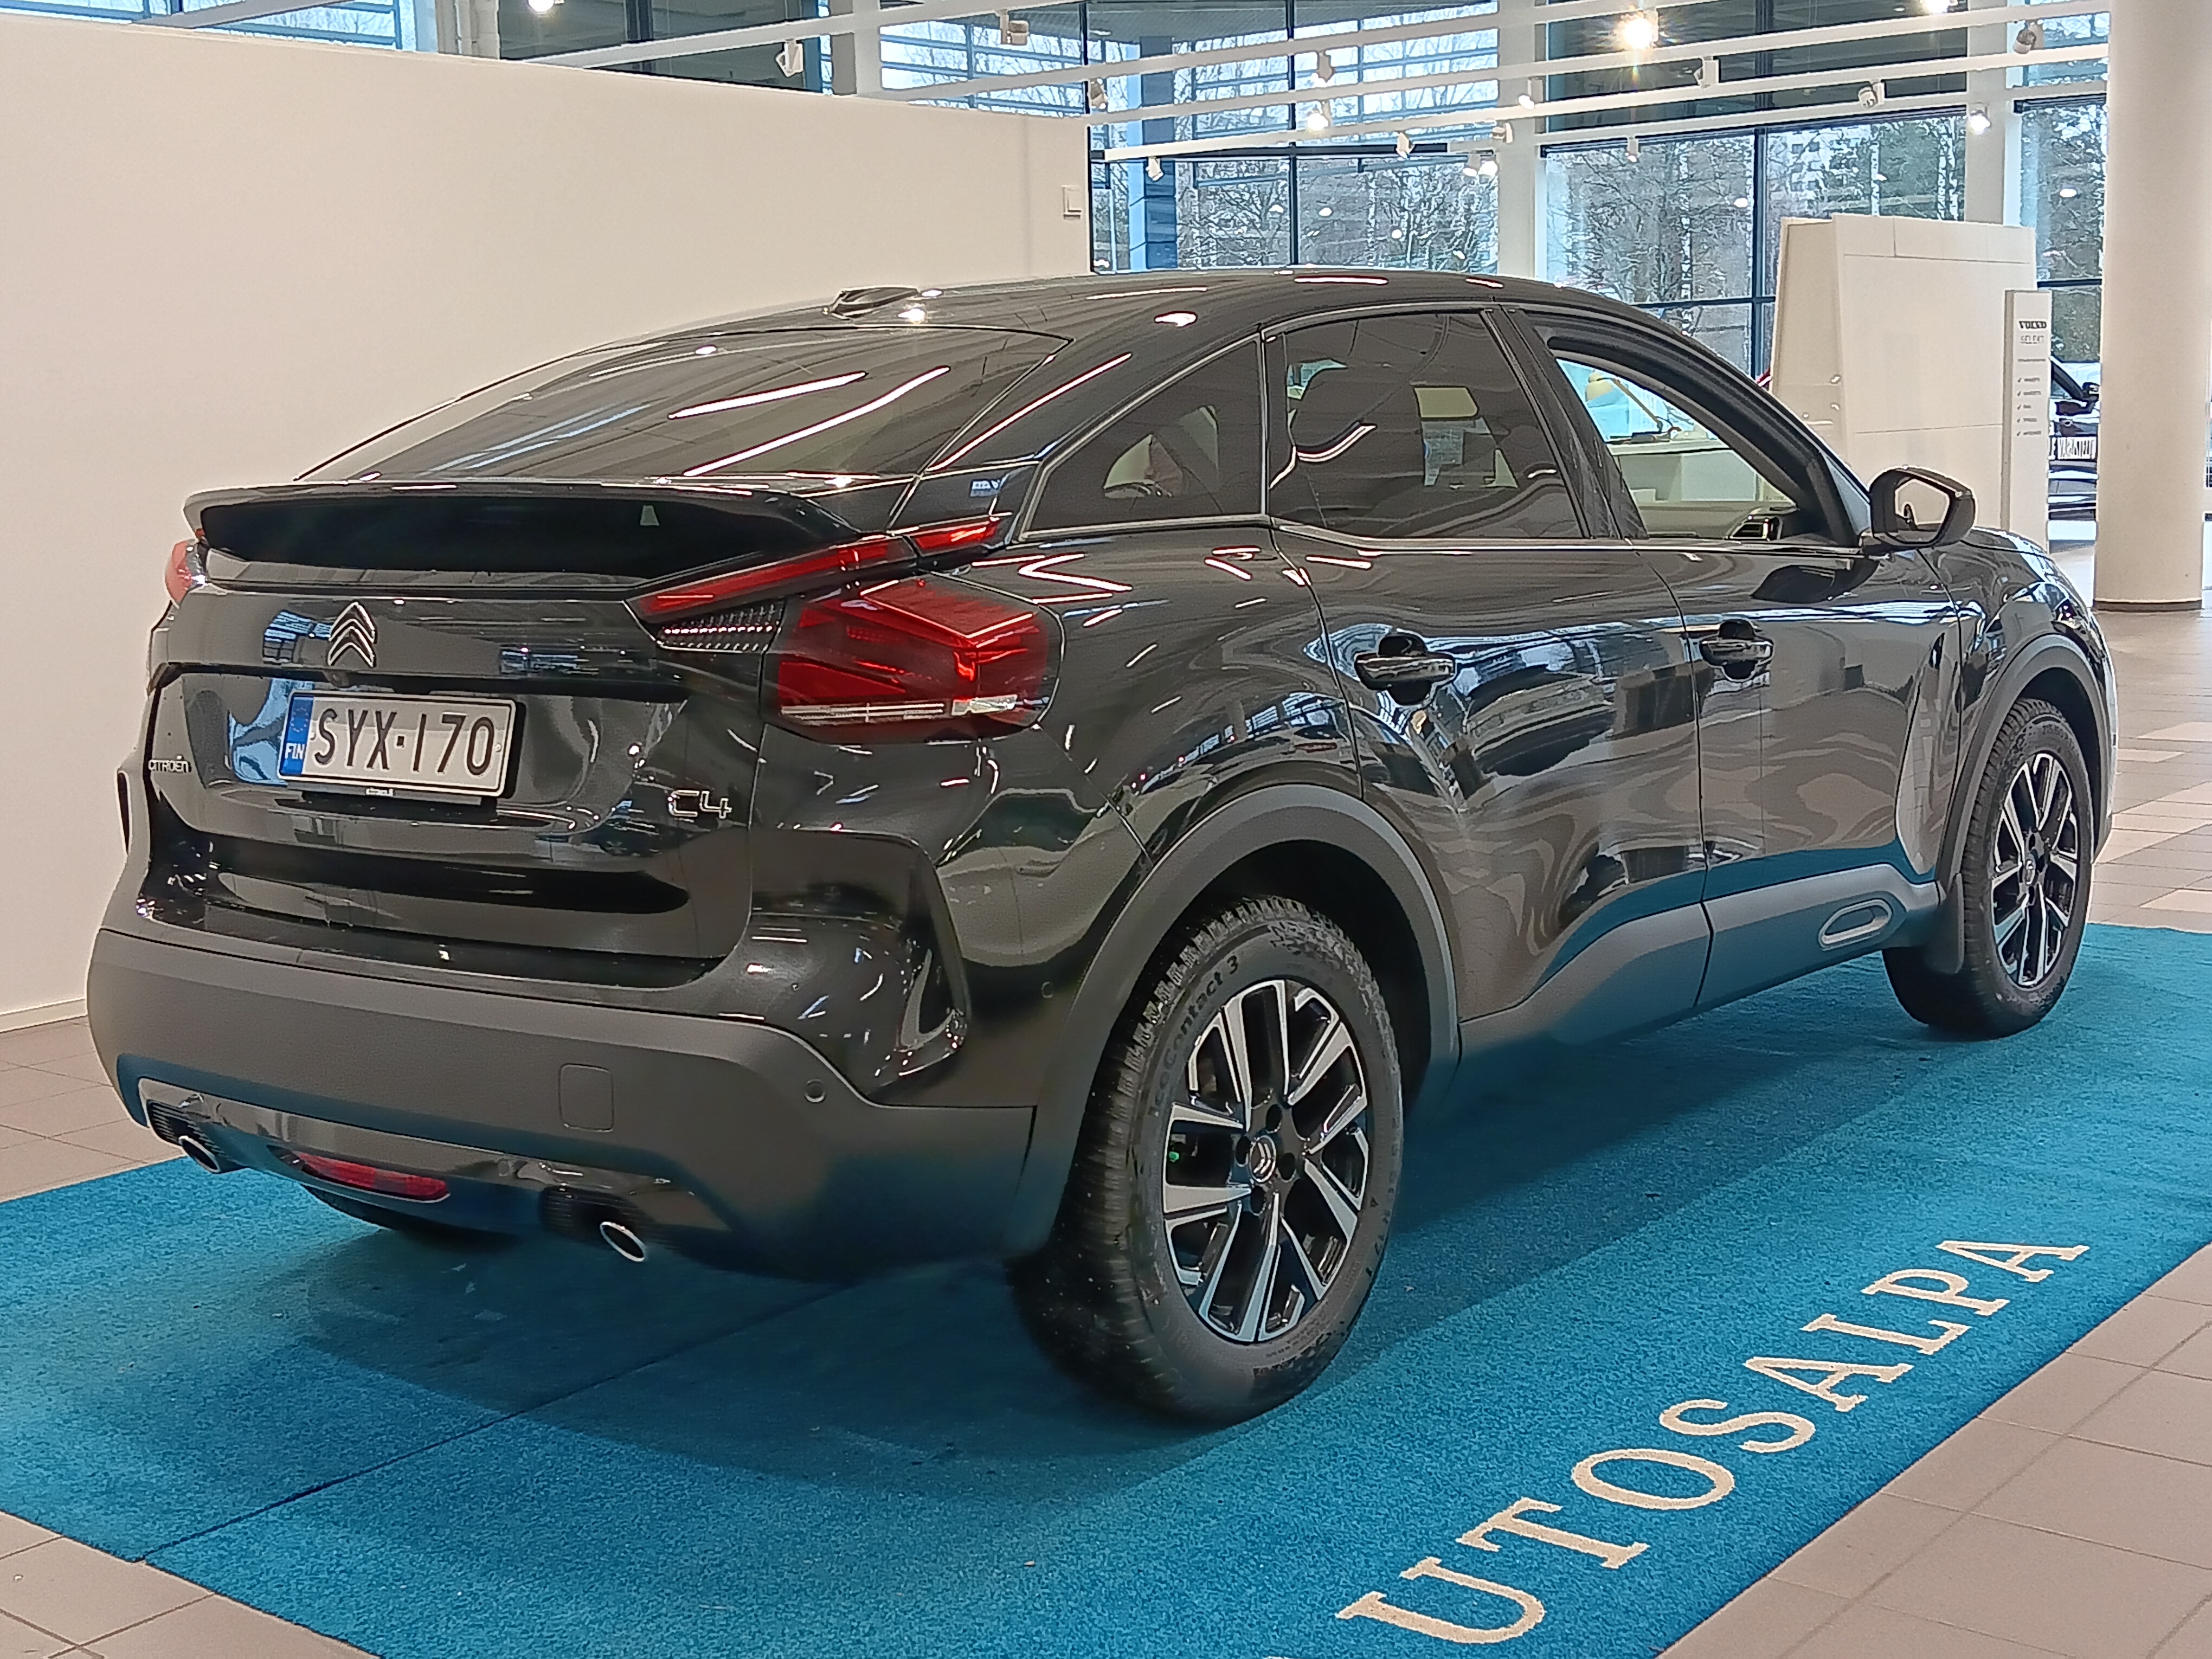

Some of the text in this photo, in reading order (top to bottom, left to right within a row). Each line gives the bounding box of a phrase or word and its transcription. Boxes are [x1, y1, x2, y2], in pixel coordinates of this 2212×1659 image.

[2018, 320, 2047, 329] VOLVO
[285, 742, 305, 760] FIN
[667, 789, 732, 819] C4
[1226, 955, 1239, 975] 3
[1334, 1239, 2091, 1645] UTOSALPA
